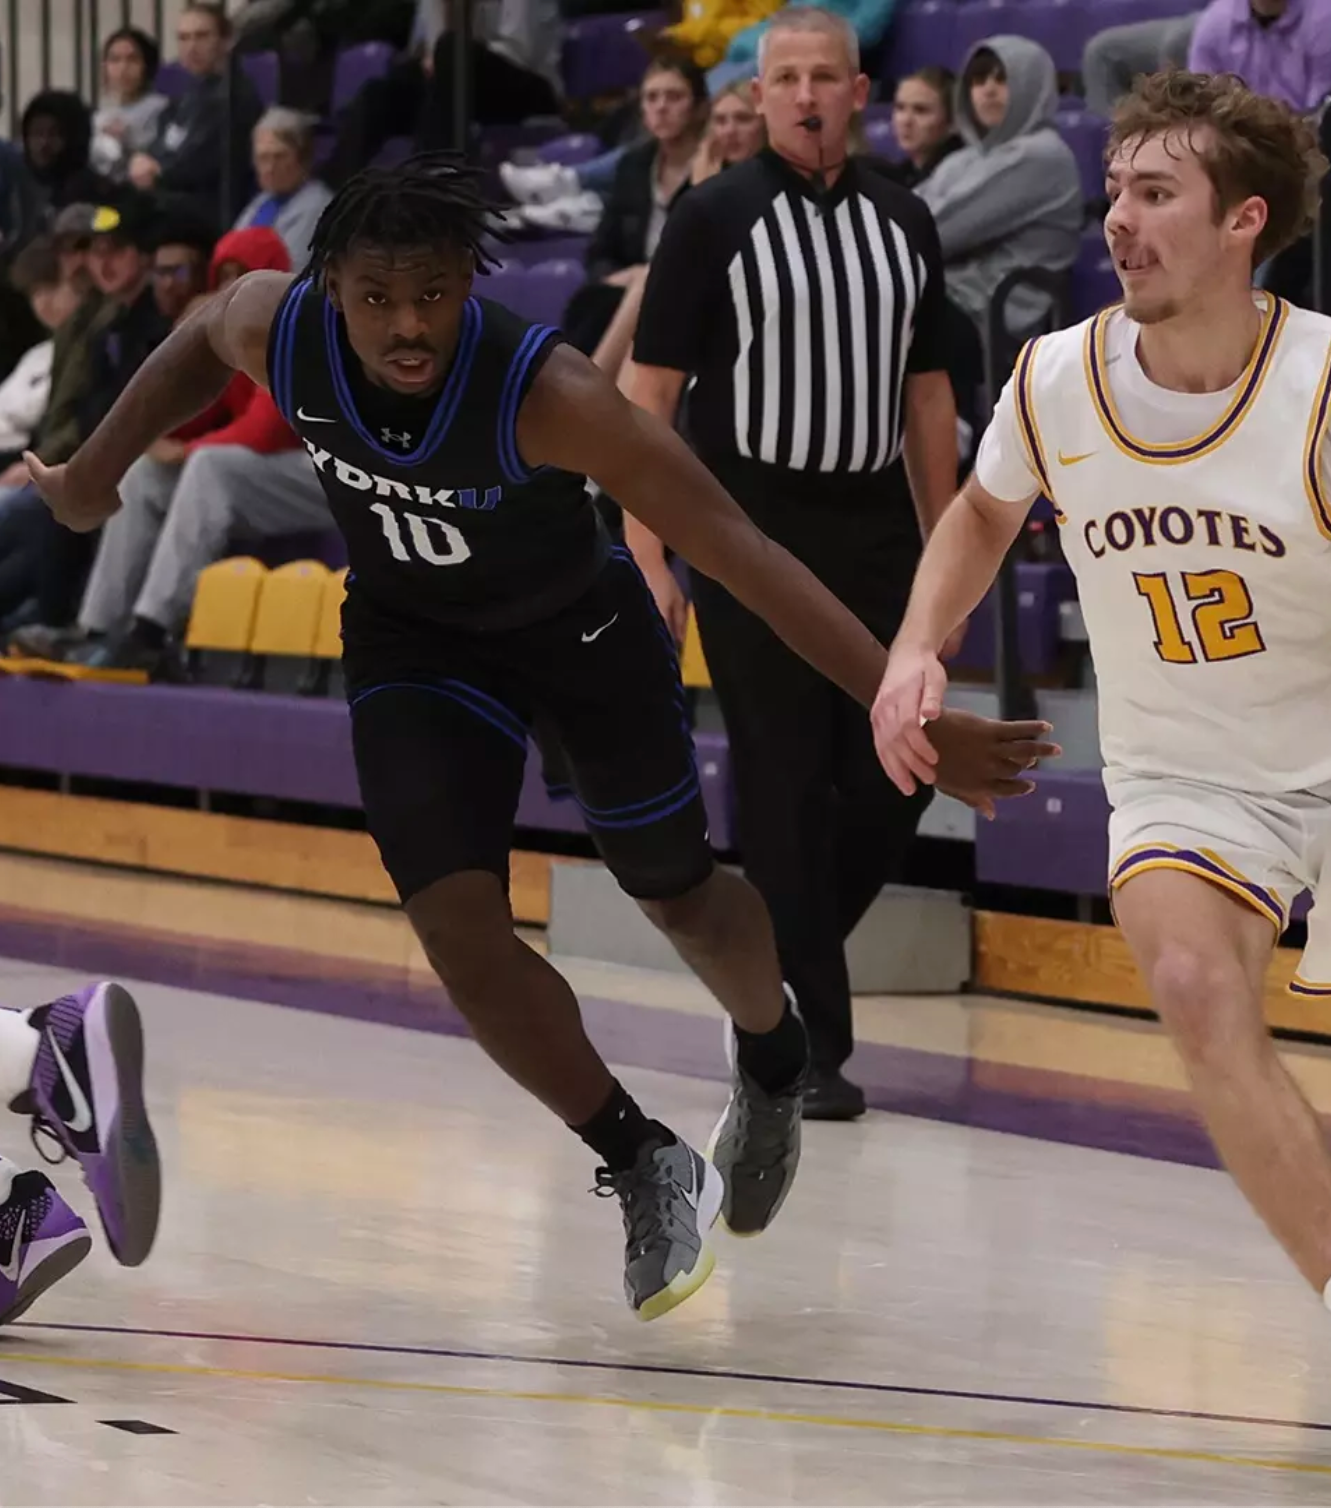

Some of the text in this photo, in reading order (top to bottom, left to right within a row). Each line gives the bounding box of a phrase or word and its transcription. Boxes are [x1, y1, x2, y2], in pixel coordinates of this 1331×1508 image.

[369, 502, 472, 566] 10
[1083, 506, 1286, 558] COYOTES
[1131, 569, 1267, 664] 12
